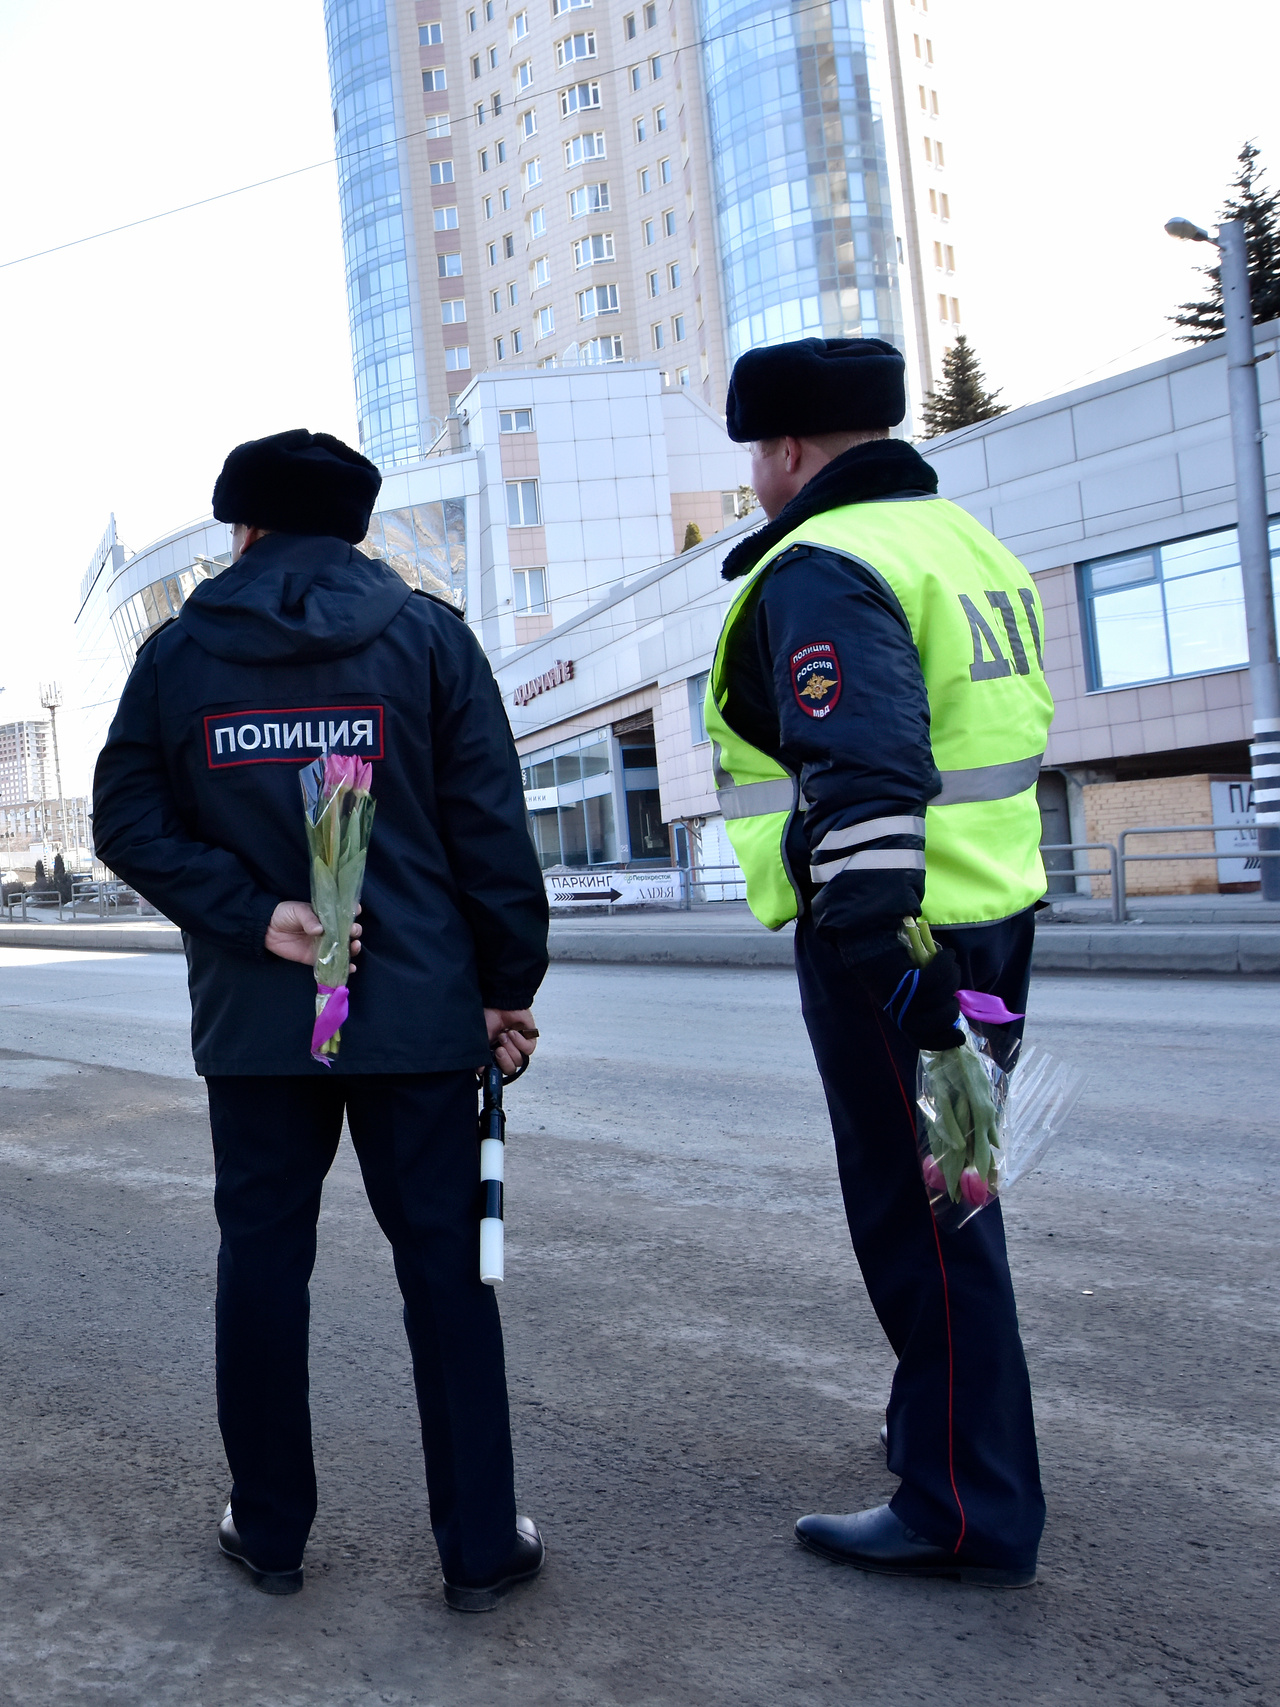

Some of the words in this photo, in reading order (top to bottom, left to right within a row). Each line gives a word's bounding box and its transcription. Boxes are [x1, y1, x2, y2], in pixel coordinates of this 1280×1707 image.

[793, 644, 831, 663] ПОЛИЦИЯ
[797, 661, 833, 681] РОССИЯ
[812, 705, 830, 717] МВД
[214, 719, 373, 754] ПОЛИЦИЯ
[551, 875, 613, 889] ПАРКИНГ
